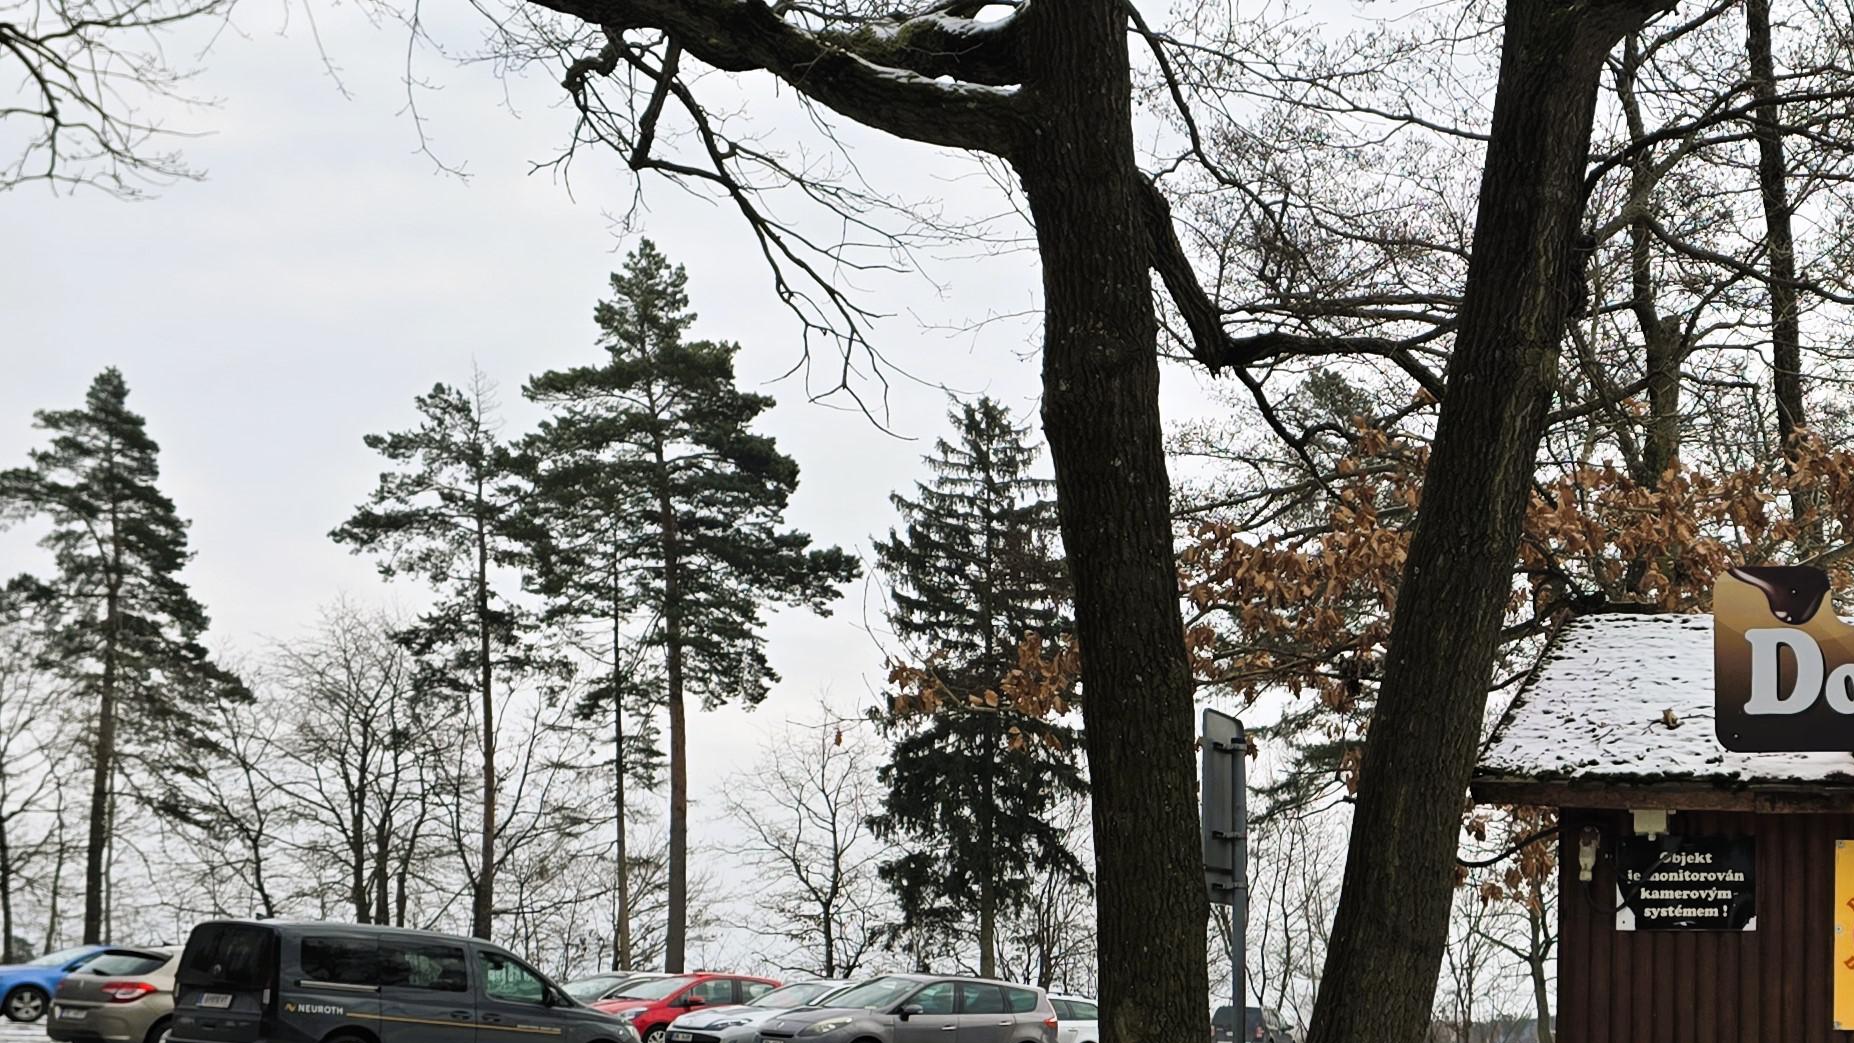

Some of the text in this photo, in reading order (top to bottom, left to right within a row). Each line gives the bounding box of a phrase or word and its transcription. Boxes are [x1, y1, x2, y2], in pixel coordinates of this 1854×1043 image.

[1659, 851, 1713, 866] Objekt
[1627, 869, 1641, 884] je
[1640, 886, 1732, 901] kamerovým
[1643, 904, 1719, 919] systémem
[298, 1004, 344, 1015] NEUROTH
